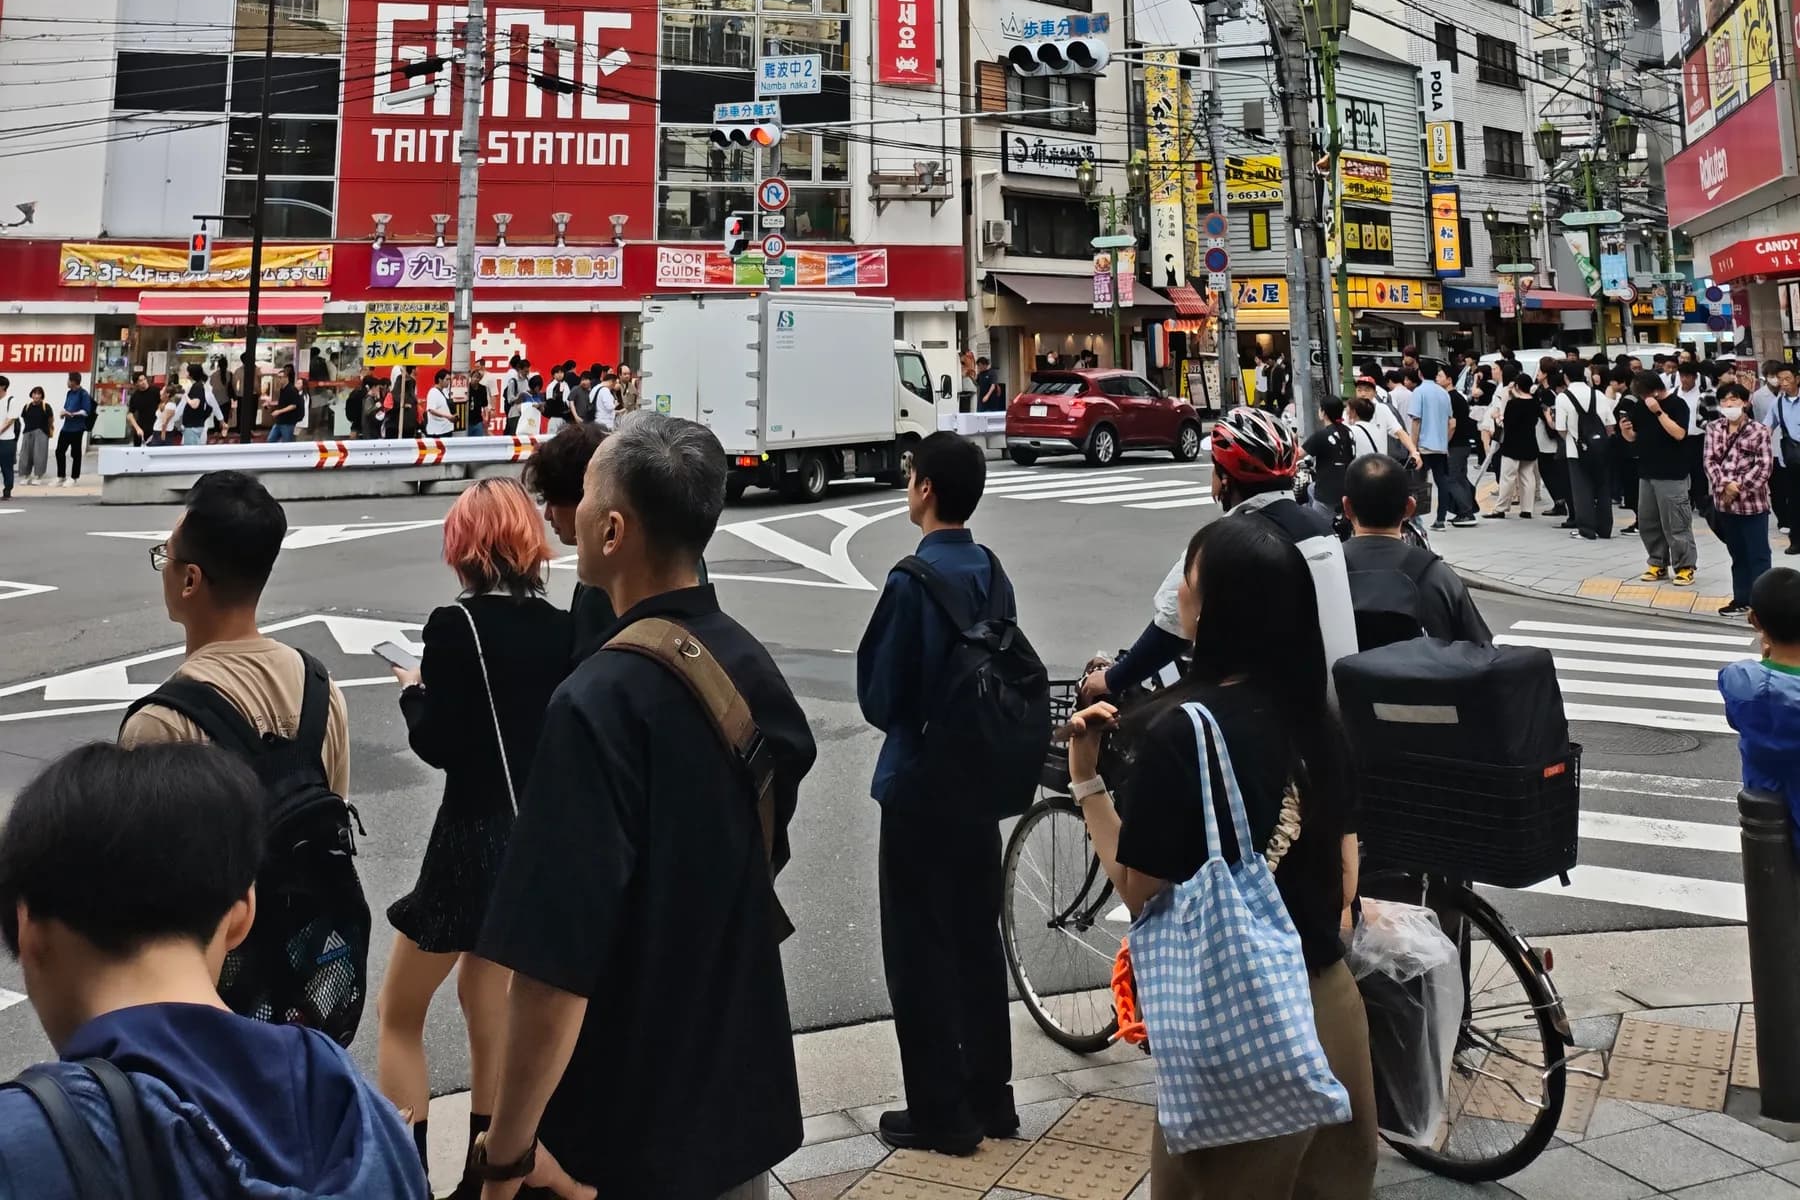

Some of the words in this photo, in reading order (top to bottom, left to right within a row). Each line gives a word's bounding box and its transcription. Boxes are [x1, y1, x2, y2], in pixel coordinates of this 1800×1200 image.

[1023, 15, 1109, 39] 歩車分離式
[373, 3, 632, 120] GAME
[764, 59, 812, 79] 難波中2
[760, 81, 787, 91] Namba
[789, 80, 808, 89] naka
[811, 79, 817, 89] 2
[1430, 70, 1443, 112] POLA
[718, 104, 777, 119] 歩車分離式
[1345, 107, 1379, 128] POLA
[489, 132, 630, 166] STATION
[1698, 146, 1729, 192] Rakuten
[767, 241, 780, 252] 40
[1755, 238, 1798, 255] CANDY
[376, 258, 401, 276] 6F
[660, 252, 702, 264] FLOOR
[661, 265, 701, 277] GUIDE
[1389, 284, 1409, 304] 松屋
[369, 316, 448, 334] ネットカフェ
[10, 344, 85, 362] STATION
